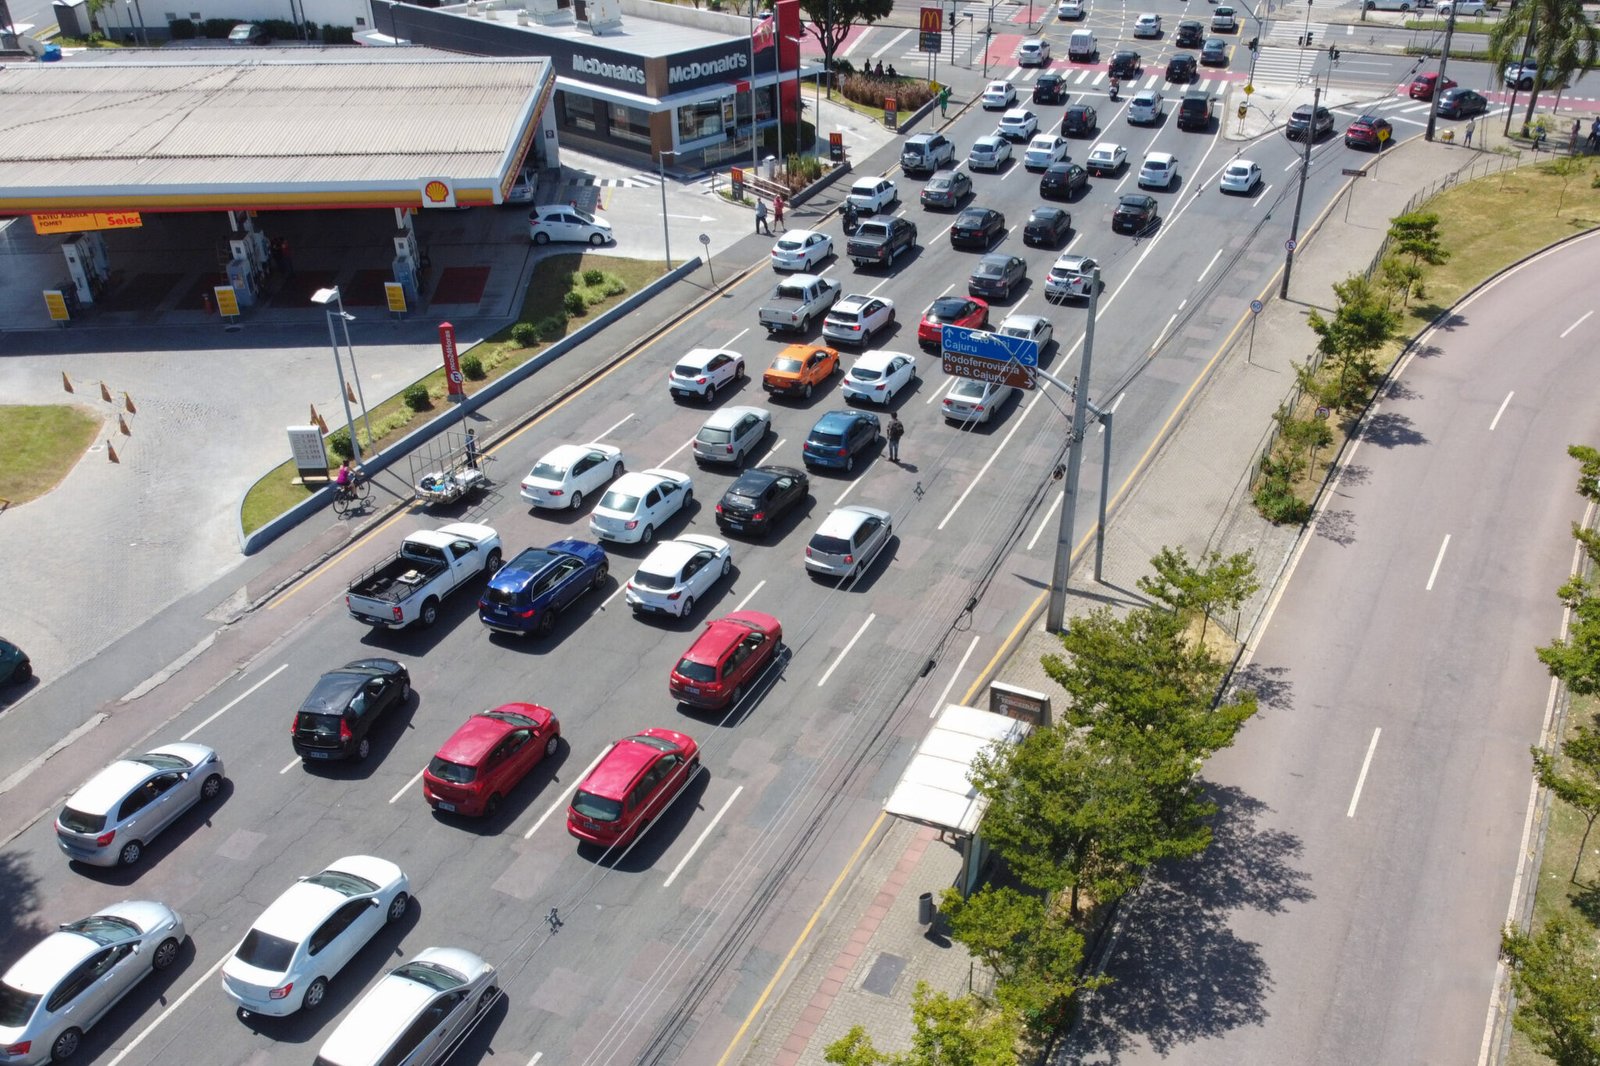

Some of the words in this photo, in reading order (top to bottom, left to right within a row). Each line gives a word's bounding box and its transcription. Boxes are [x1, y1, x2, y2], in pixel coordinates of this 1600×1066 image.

[572, 54, 646, 84] McDonald's
[668, 52, 748, 84] McDonald's
[944, 339, 978, 352] Cajuru
[944, 353, 1020, 374] Rodoferroviária
[955, 366, 971, 376] P.S.
[973, 369, 1006, 383] Cajuru
